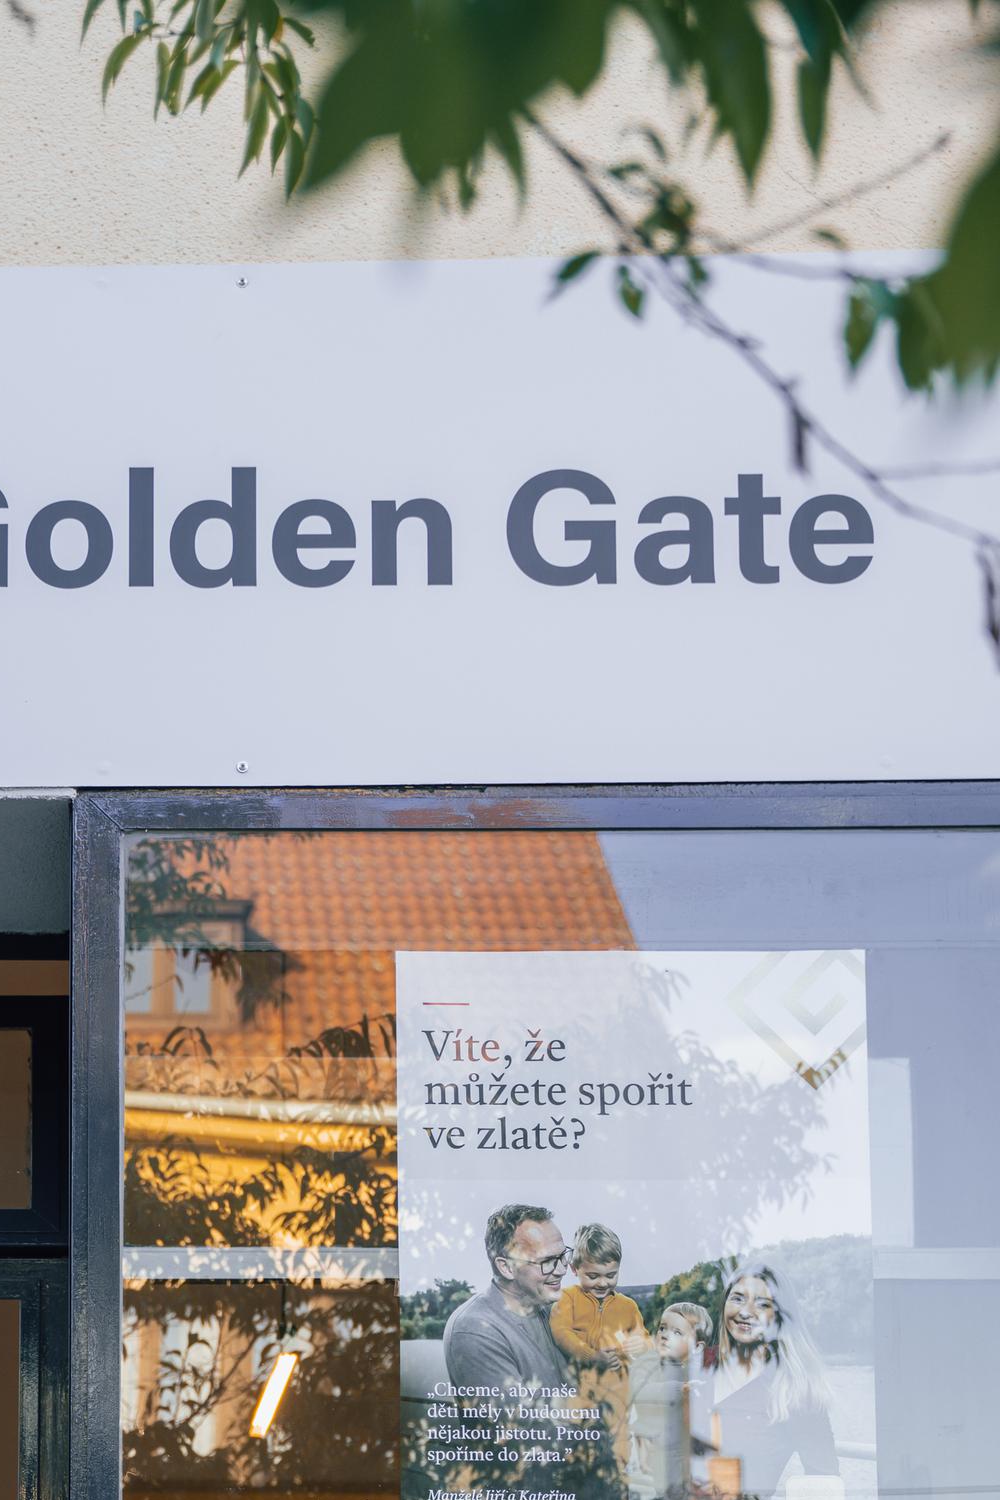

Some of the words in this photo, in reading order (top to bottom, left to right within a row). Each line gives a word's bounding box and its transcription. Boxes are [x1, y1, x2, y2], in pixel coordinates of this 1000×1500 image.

[505, 468, 875, 586] Gate
[421, 1028, 513, 1070] Víte,
[524, 1028, 566, 1062] že
[424, 1072, 567, 1106] můžete
[578, 1072, 693, 1116] spořit
[422, 1126, 466, 1149] ve
[476, 1116, 586, 1150] zlatě?
[427, 1382, 505, 1400] „Chceme,
[509, 1383, 537, 1401] aby
[541, 1383, 577, 1398] naše
[427, 1403, 459, 1419] děti
[463, 1403, 502, 1422] měly
[506, 1408, 516, 1419] v
[519, 1403, 601, 1420] budoucnu
[427, 1425, 491, 1443] nějakou
[494, 1425, 552, 1444] jistotu.
[556, 1426, 601, 1441] Proto
[427, 1446, 494, 1466] spoříme
[498, 1446, 519, 1462] do
[523, 1446, 573, 1463] zlata.”
